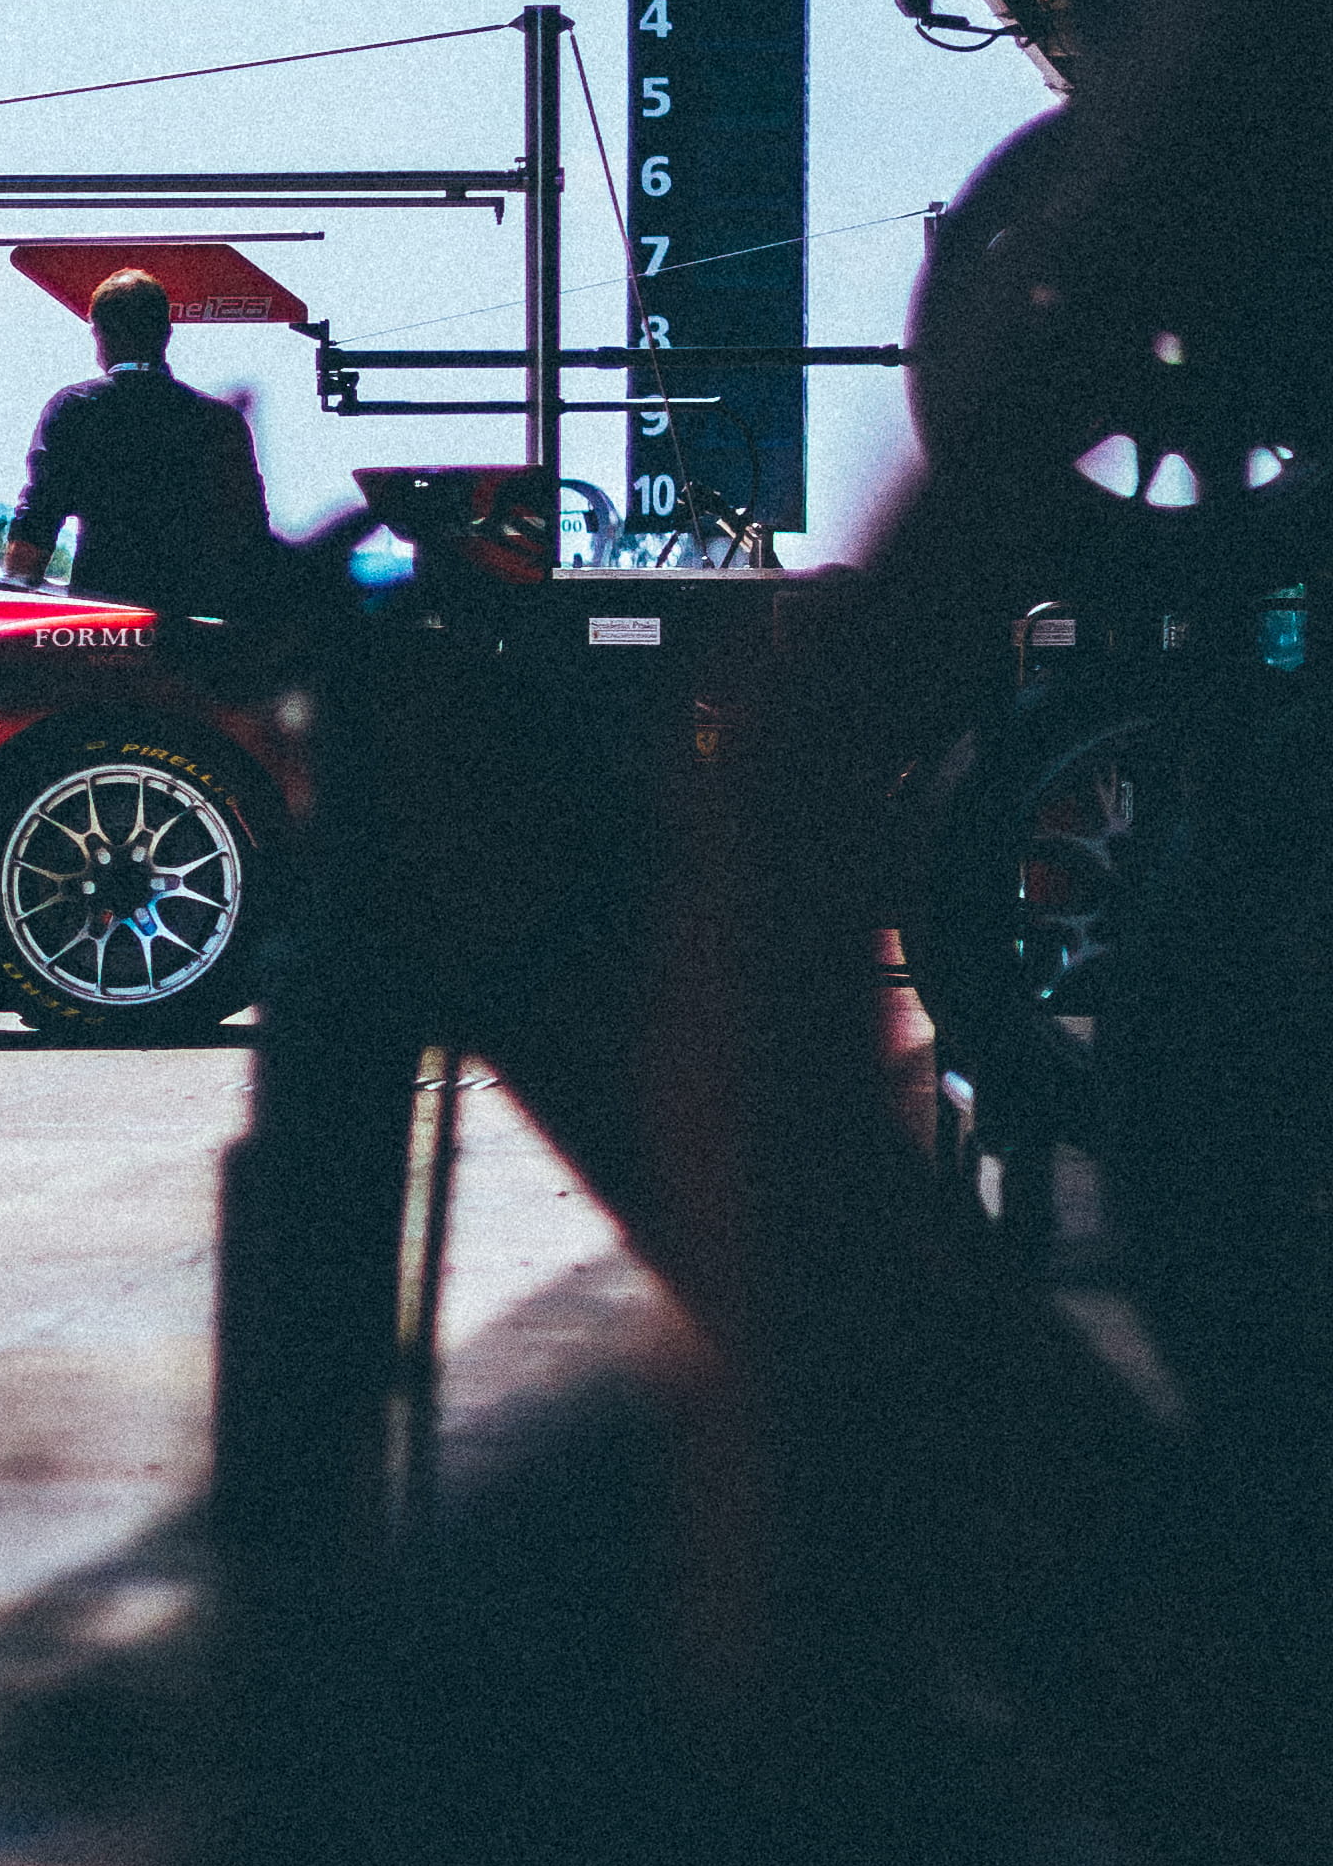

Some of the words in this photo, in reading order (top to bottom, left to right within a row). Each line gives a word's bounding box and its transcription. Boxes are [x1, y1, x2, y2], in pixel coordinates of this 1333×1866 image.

[642, 77, 671, 117] 5
[641, 156, 672, 197] 6
[641, 236, 670, 276] 7
[639, 315, 672, 349] 8
[640, 395, 670, 436] 9
[633, 475, 675, 516] 10
[121, 742, 225, 794] PIRELLI
